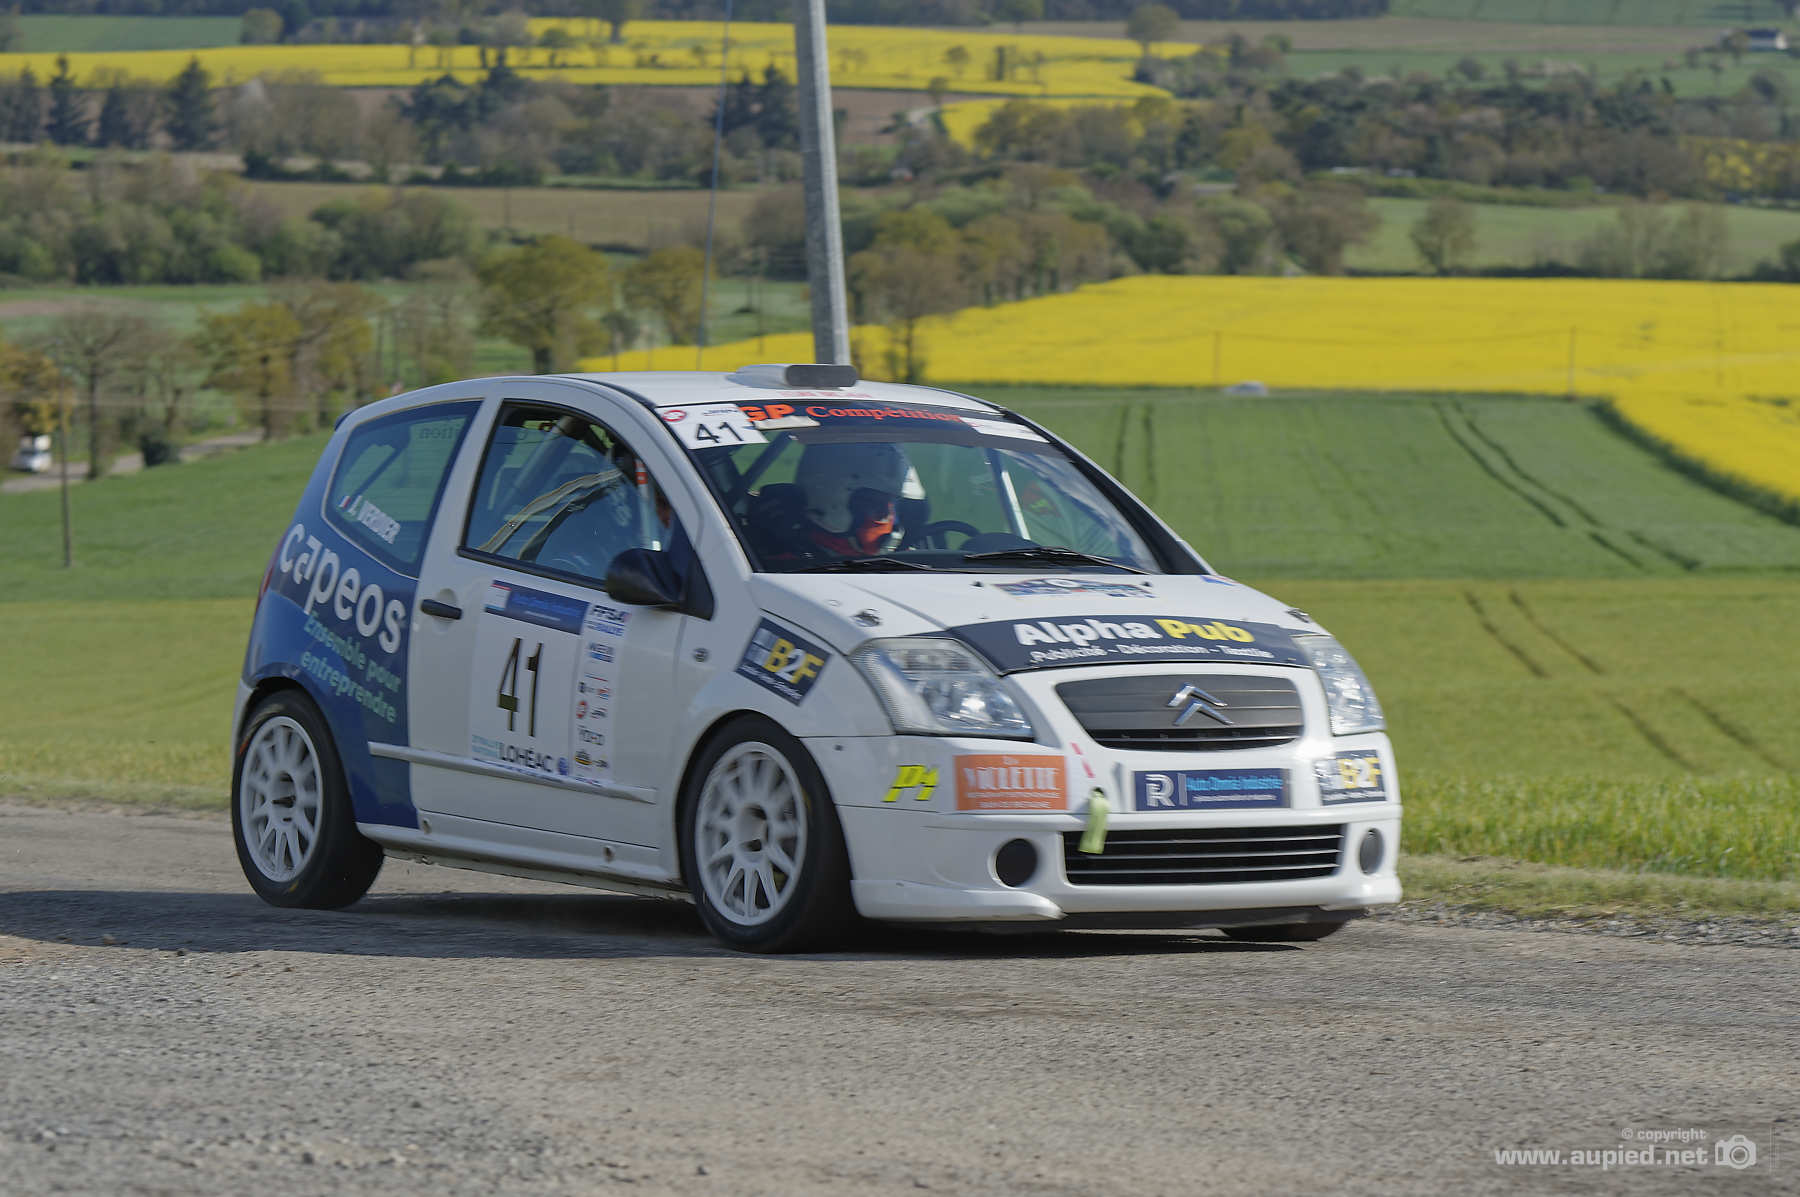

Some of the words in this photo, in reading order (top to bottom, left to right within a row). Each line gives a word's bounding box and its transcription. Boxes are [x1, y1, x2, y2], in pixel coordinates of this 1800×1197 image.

[695, 421, 744, 443] 41
[279, 524, 406, 654] capeos
[1013, 618, 1163, 647] Alpha
[1153, 618, 1255, 643] Pub
[763, 637, 825, 685] B2F
[301, 651, 397, 723] entreprendre
[497, 637, 543, 738] 41
[1339, 757, 1382, 789] B2F
